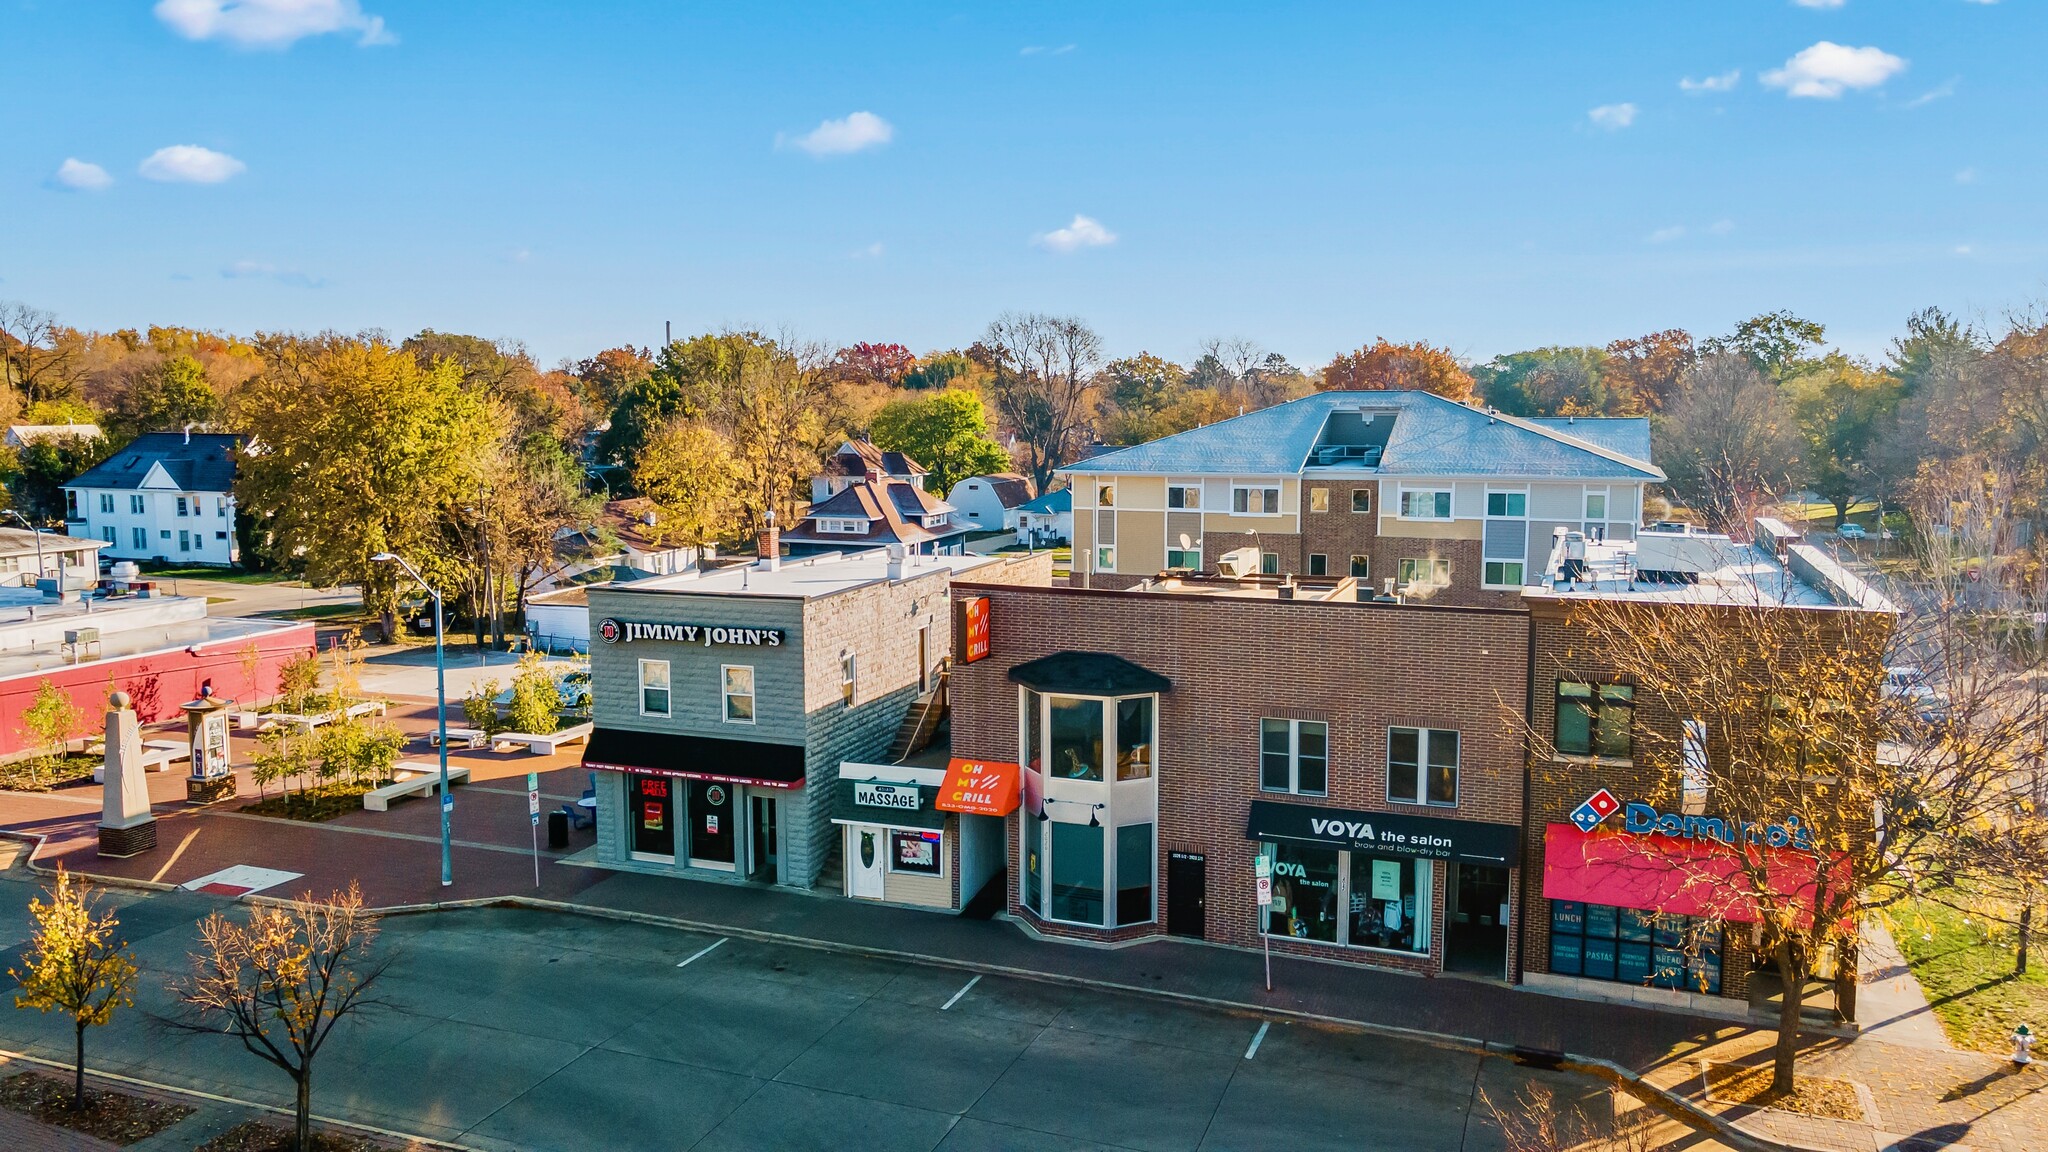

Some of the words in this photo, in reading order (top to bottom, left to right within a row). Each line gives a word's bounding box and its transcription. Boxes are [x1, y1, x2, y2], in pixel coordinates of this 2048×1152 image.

[969, 605, 979, 618] OH
[625, 622, 698, 642] JIMMY
[703, 627, 780, 647] JOHN'S
[969, 624, 979, 638] MY
[969, 640, 987, 657] GRILL
[962, 763, 983, 774] OH
[642, 780, 667, 790] FREE
[957, 778, 978, 788] MY
[858, 791, 915, 807] MASSAGE
[952, 791, 991, 804] GRILL
[1311, 818, 1375, 840] VOYA
[1381, 831, 1406, 843] the
[1410, 835, 1452, 848] salon
[1626, 803, 1813, 850] Domino's
[1354, 841, 1375, 849] brow
[1377, 843, 1395, 852] and
[1397, 844, 1433, 856] blow-dry
[1435, 848, 1451, 857] bar
[1554, 913, 1582, 923] LUNCH
[1656, 920, 1683, 933] LATE
[1586, 951, 1614, 962] PASTAS
[1655, 954, 1681, 965] BREAD
